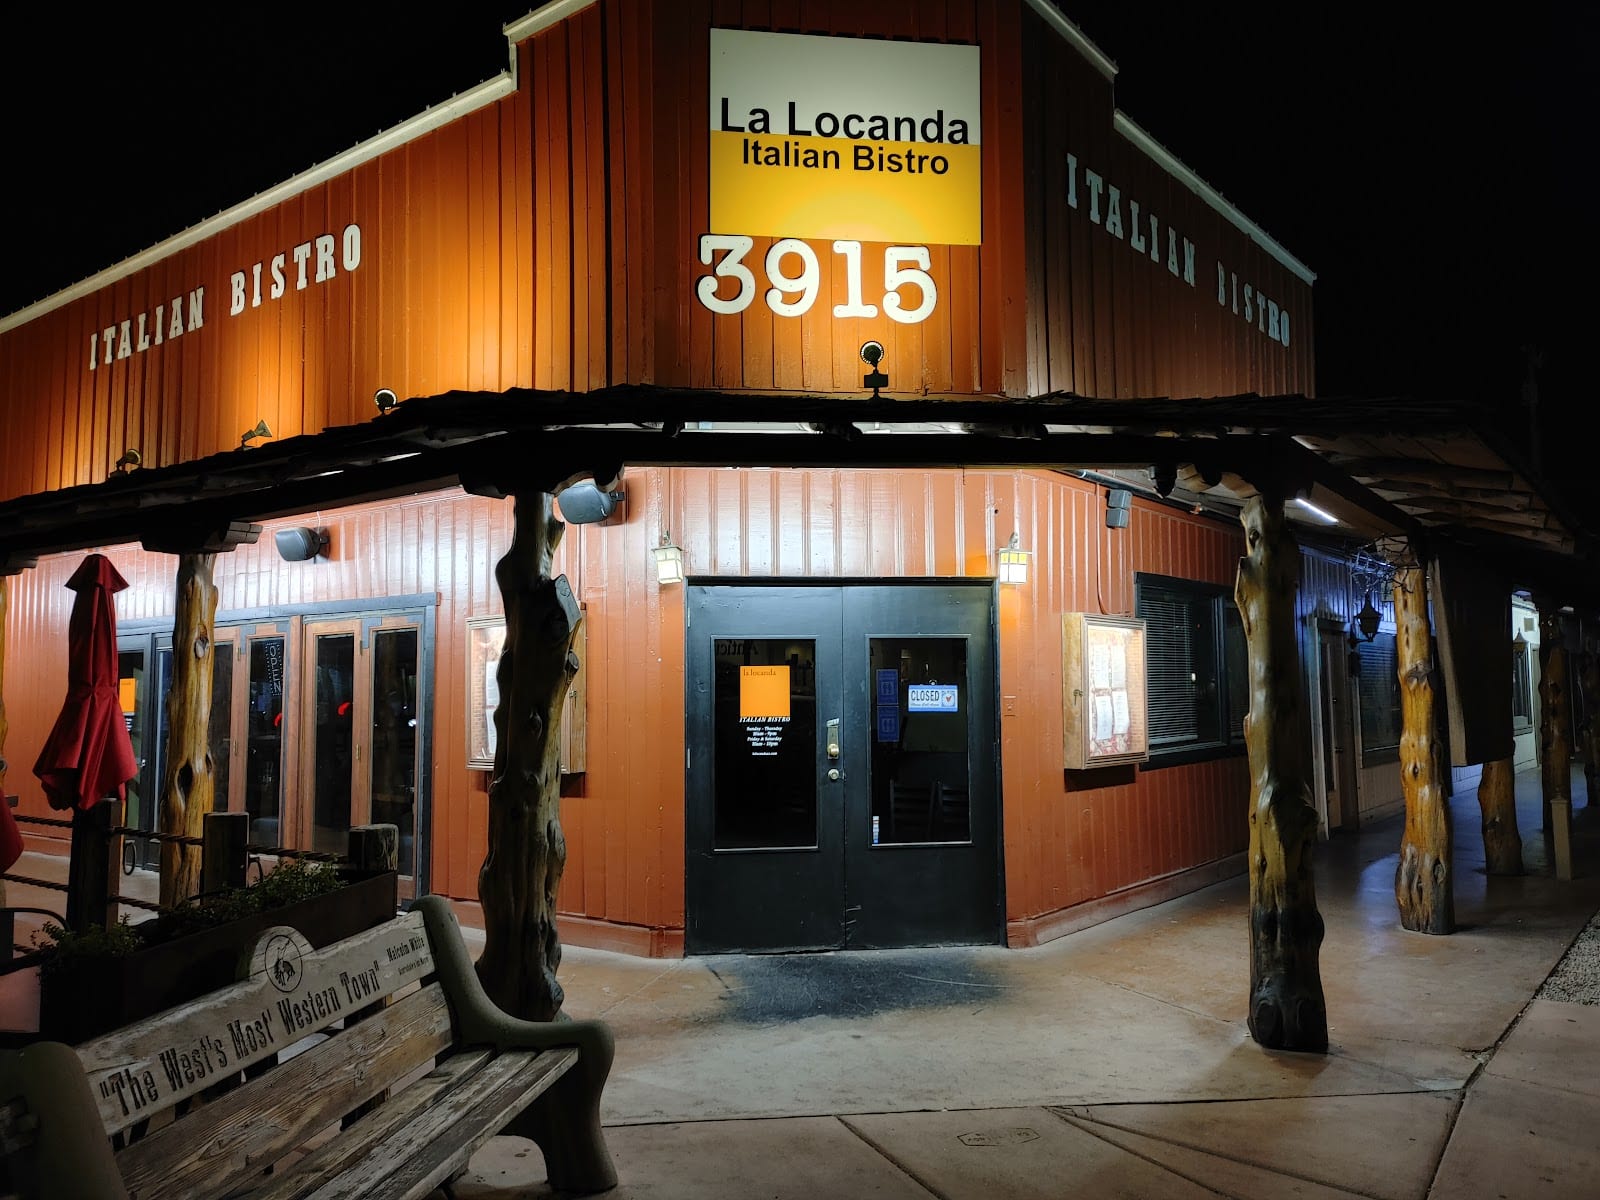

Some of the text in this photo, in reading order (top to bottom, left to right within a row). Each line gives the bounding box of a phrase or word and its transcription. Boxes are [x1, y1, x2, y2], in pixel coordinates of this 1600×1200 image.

[721, 97, 969, 145] La Locanda
[743, 138, 949, 175] Italian Bistro
[696, 234, 938, 324] 3915
[1067, 152, 1290, 347] ITALIAN BISTRO
[89, 224, 361, 370] ITALIAN BISTRO
[269, 645, 281, 692] OPEN
[911, 690, 940, 702] CLOSED
[99, 1067, 159, 1117] "The
[159, 1035, 228, 1092] West's
[277, 985, 341, 1036] Western
[339, 960, 381, 1004] Town"
